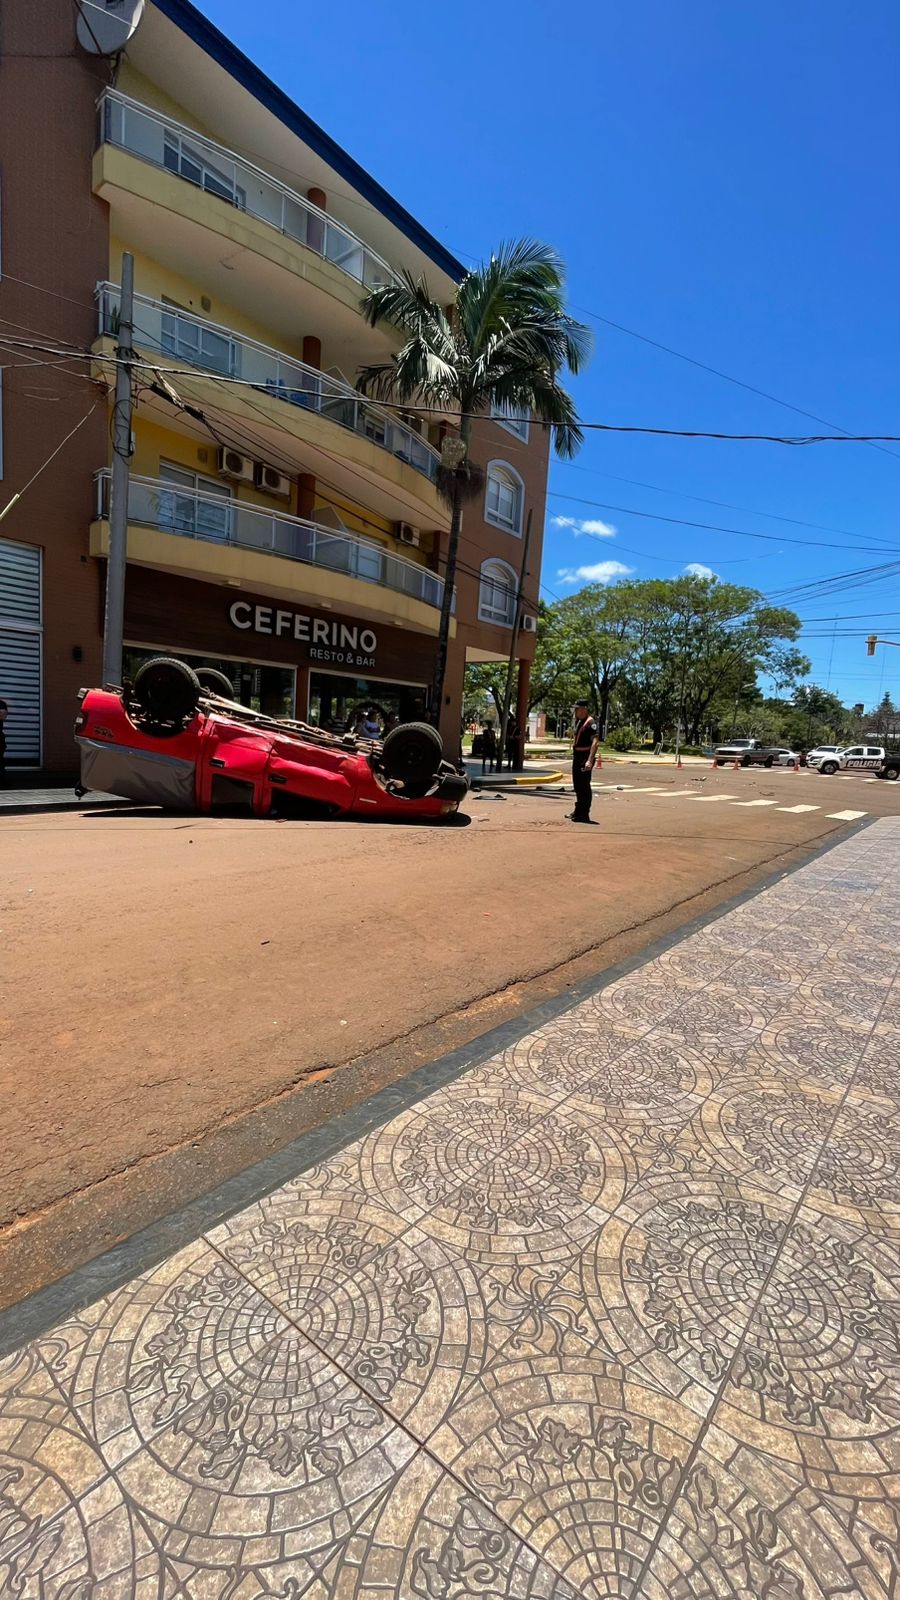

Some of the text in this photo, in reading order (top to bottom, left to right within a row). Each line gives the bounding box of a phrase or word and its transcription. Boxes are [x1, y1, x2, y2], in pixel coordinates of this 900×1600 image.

[229, 601, 377, 653] CEFERINO
[310, 648, 376, 667] RESTO & BAR
[847, 760, 882, 768] POLICIA
